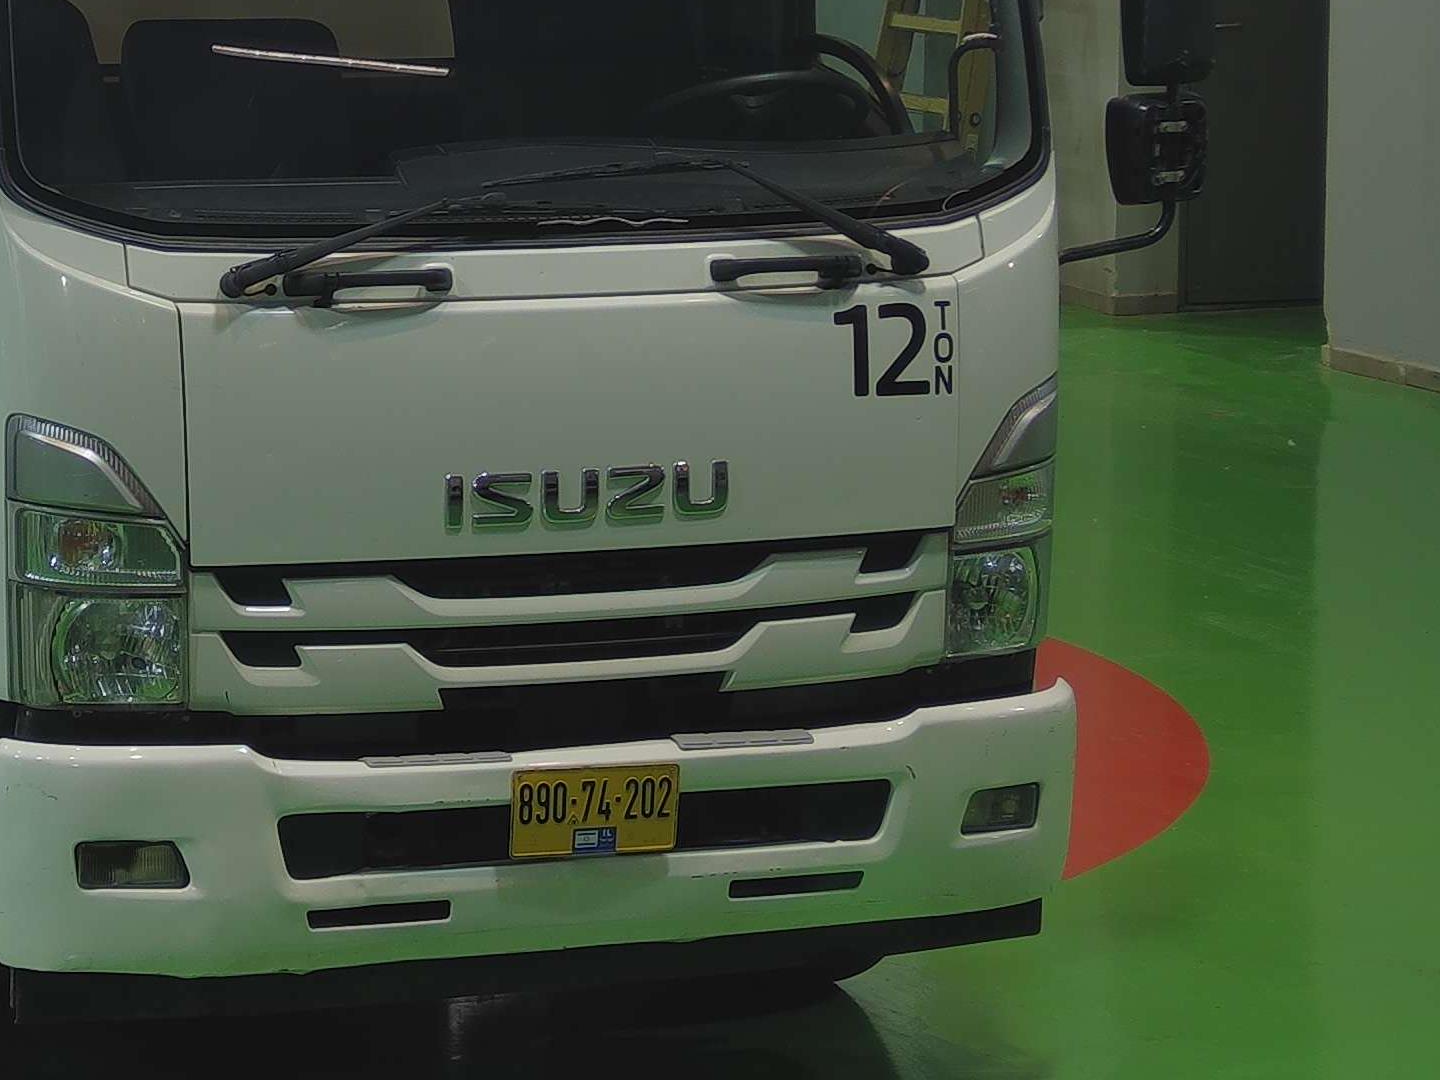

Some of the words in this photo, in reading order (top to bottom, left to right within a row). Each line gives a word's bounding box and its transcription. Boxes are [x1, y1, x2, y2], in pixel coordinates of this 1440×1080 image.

[833, 302, 931, 397] 12
[933, 300, 954, 395] TON
[444, 460, 730, 533] ISUZU
